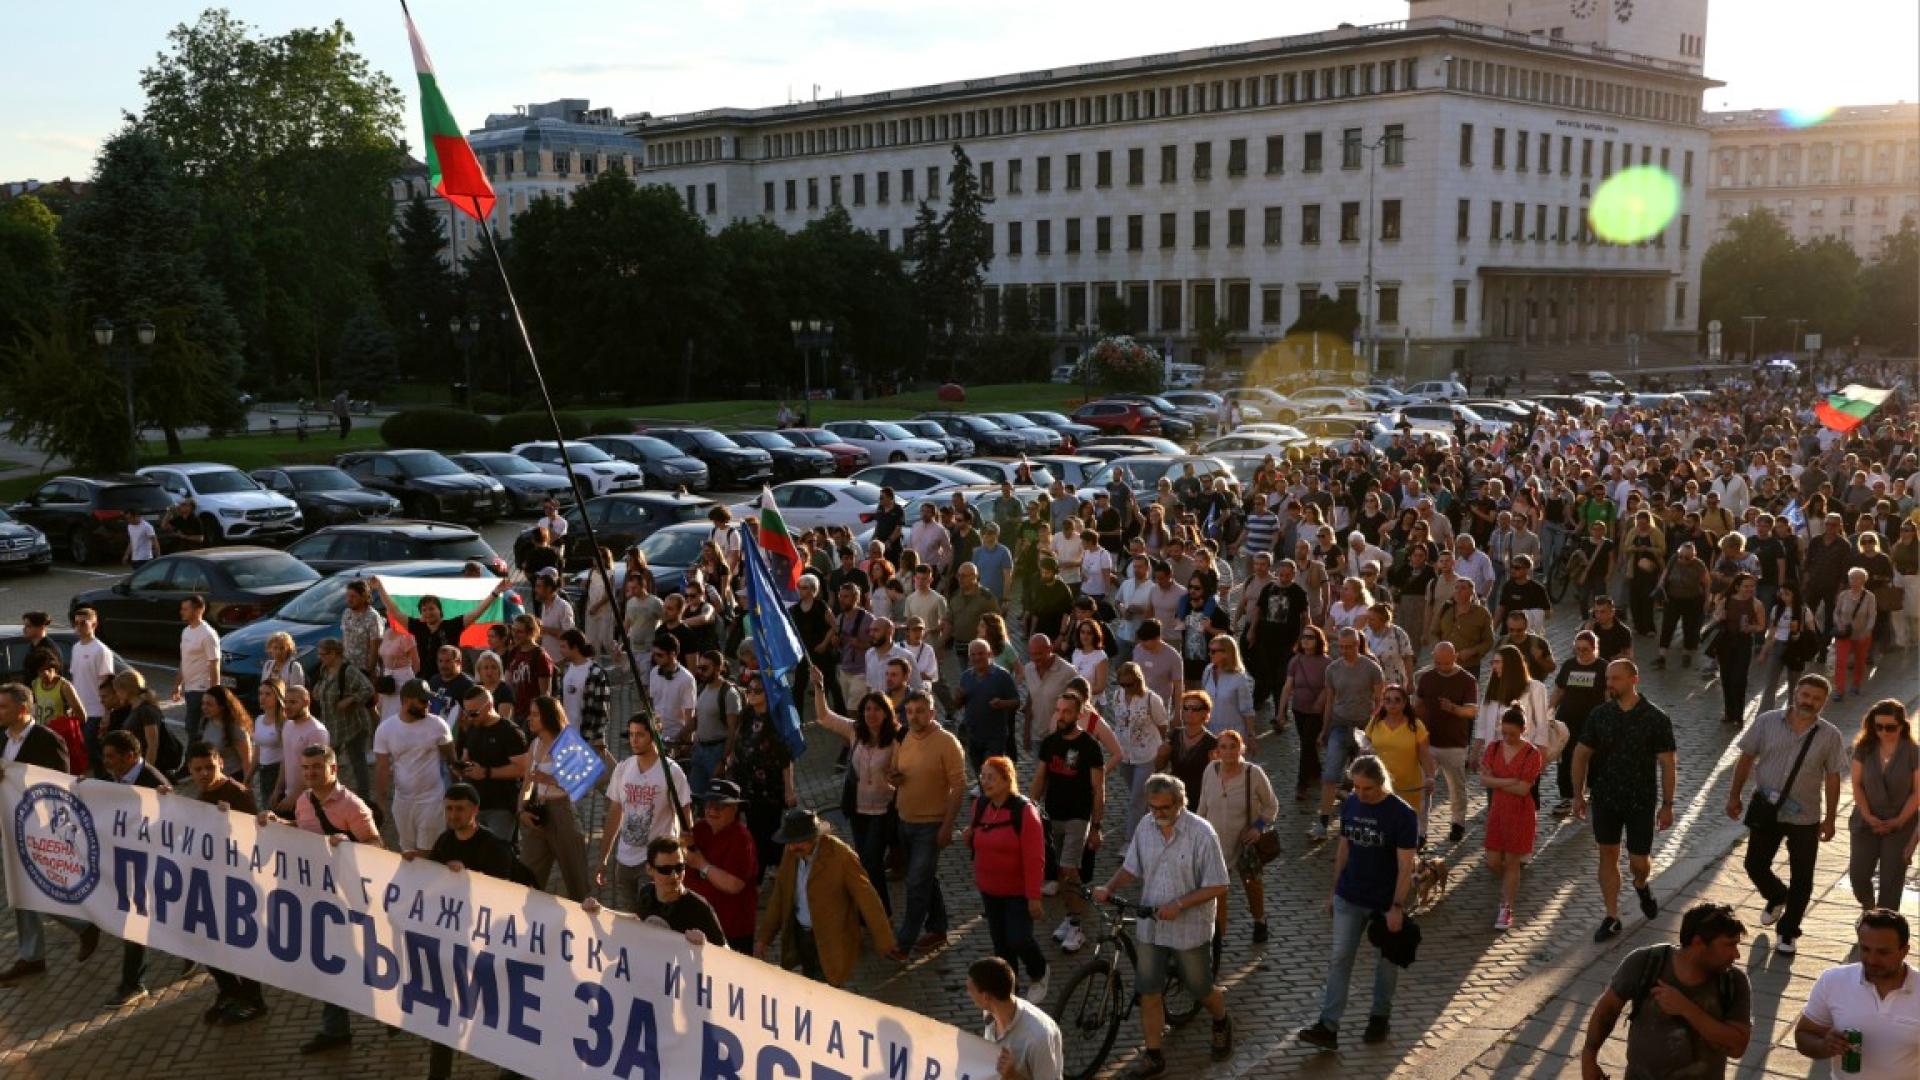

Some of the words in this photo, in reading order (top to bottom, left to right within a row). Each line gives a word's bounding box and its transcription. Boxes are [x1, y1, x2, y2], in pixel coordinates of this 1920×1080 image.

[112, 809, 337, 894] НАЦИОНАЛНА
[359, 877, 631, 982] ГРАЖДАНСКА
[113, 846, 545, 1046] ПРАВОСЪДИЕ
[572, 981, 660, 1080] ЗА
